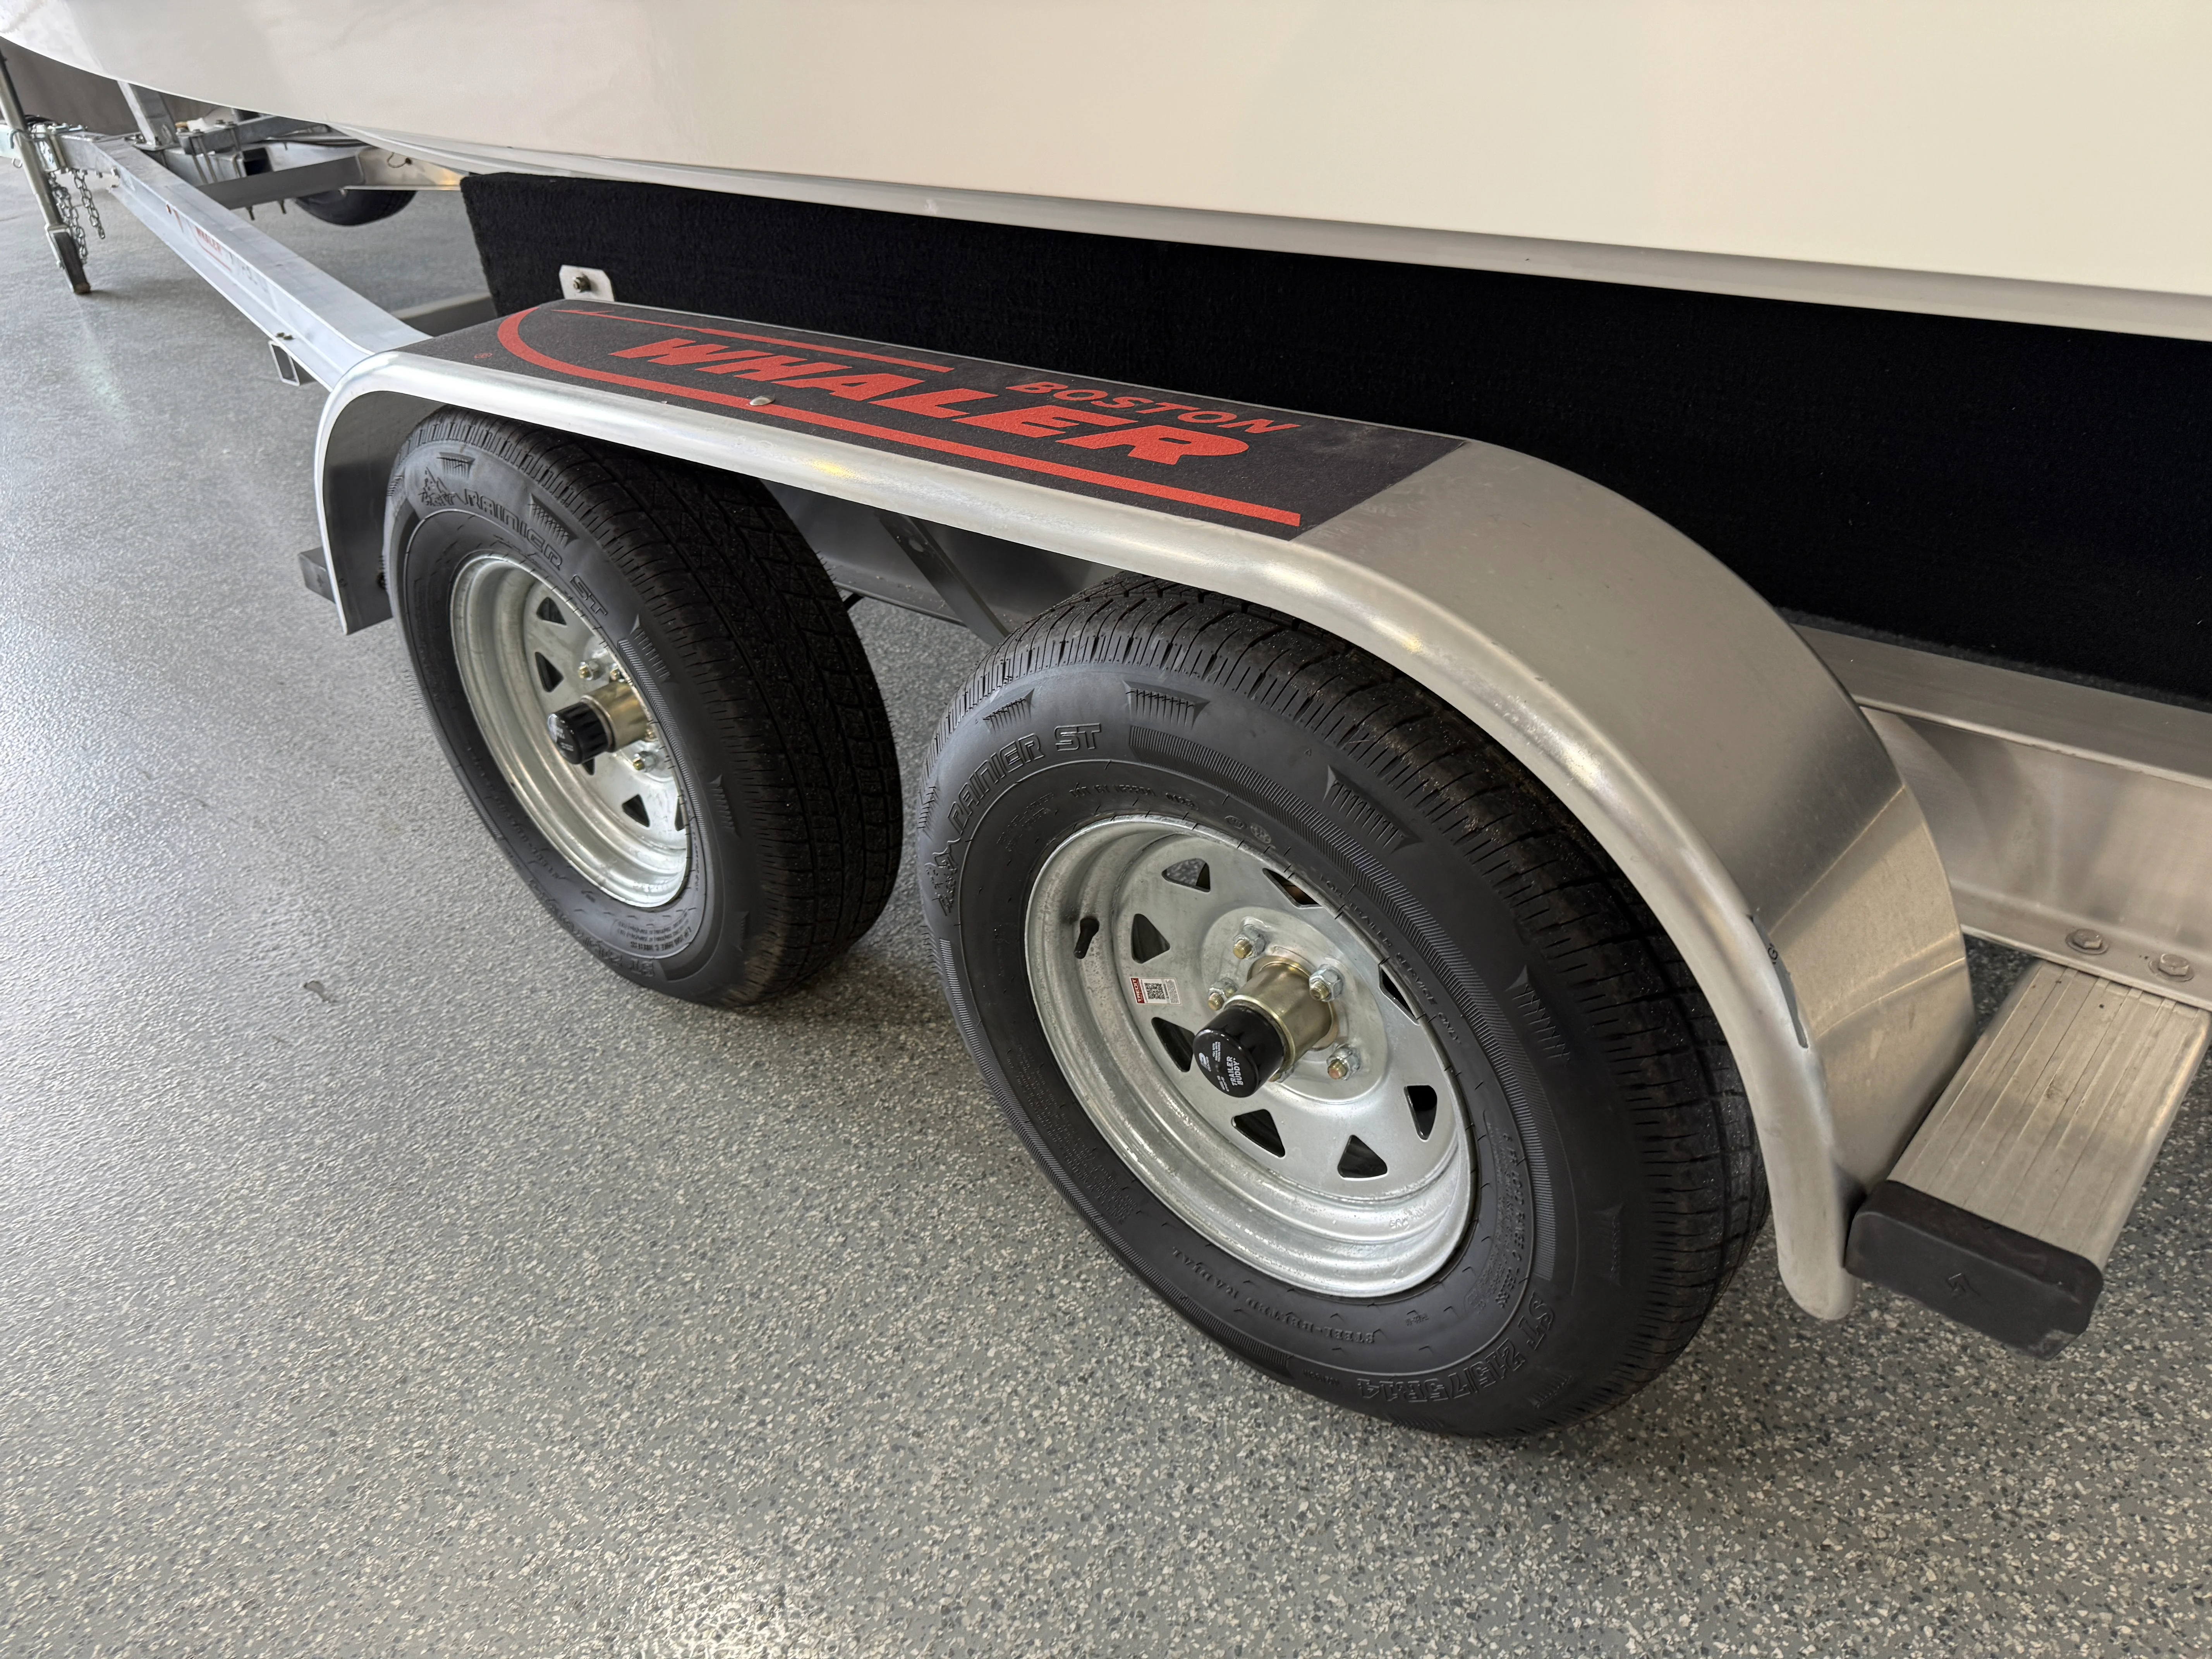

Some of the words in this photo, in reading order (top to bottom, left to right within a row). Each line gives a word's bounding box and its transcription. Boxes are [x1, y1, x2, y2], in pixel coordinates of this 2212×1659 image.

[608, 338, 1249, 465] WHALER
[1006, 381, 1301, 433] BOSTON
[465, 488, 563, 571] RAINIER
[570, 574, 608, 616] ST
[948, 733, 1046, 834] RAINIER
[1054, 722, 1101, 752] ST
[1226, 1056, 1238, 1086] TRAILER
[1518, 1290, 1555, 1351] ST
[1358, 1339, 1527, 1403] 215/75R14
